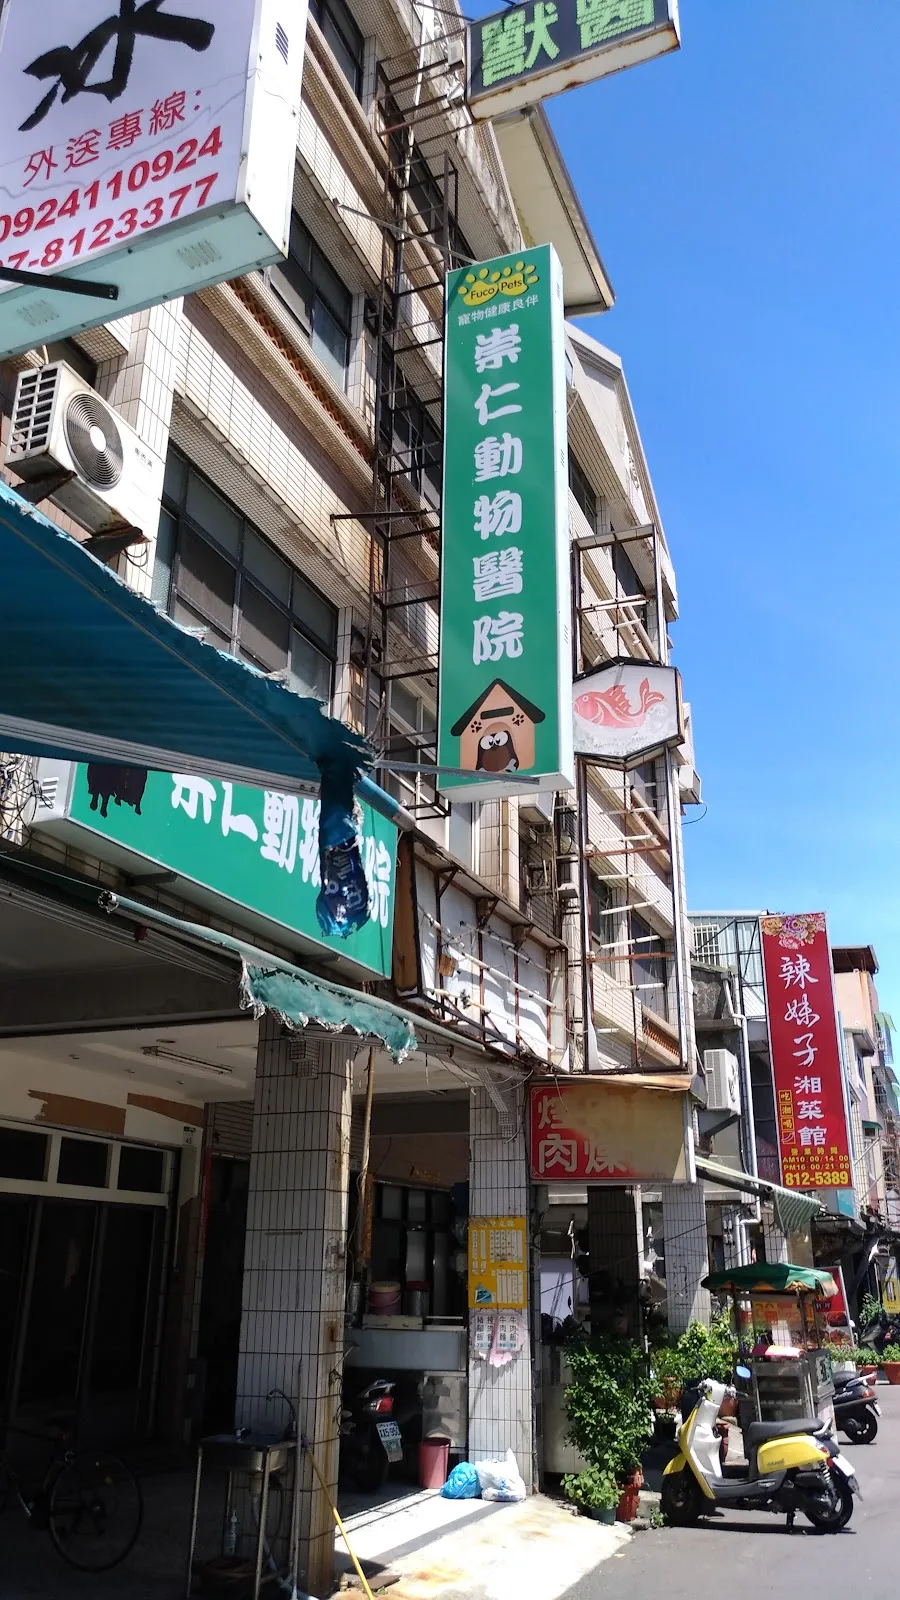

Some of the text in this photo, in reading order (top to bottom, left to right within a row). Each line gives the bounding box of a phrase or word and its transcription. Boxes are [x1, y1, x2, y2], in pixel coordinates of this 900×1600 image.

[0, 126, 224, 244] 0924110924
[0, 172, 219, 270] 7-8123377
[457, 294, 539, 327] 寵物健康良伴
[470, 279, 522, 300] Fuco Pets
[472, 323, 523, 666] 崇仁動物醫院
[785, 1171, 849, 1186] 812-5389
